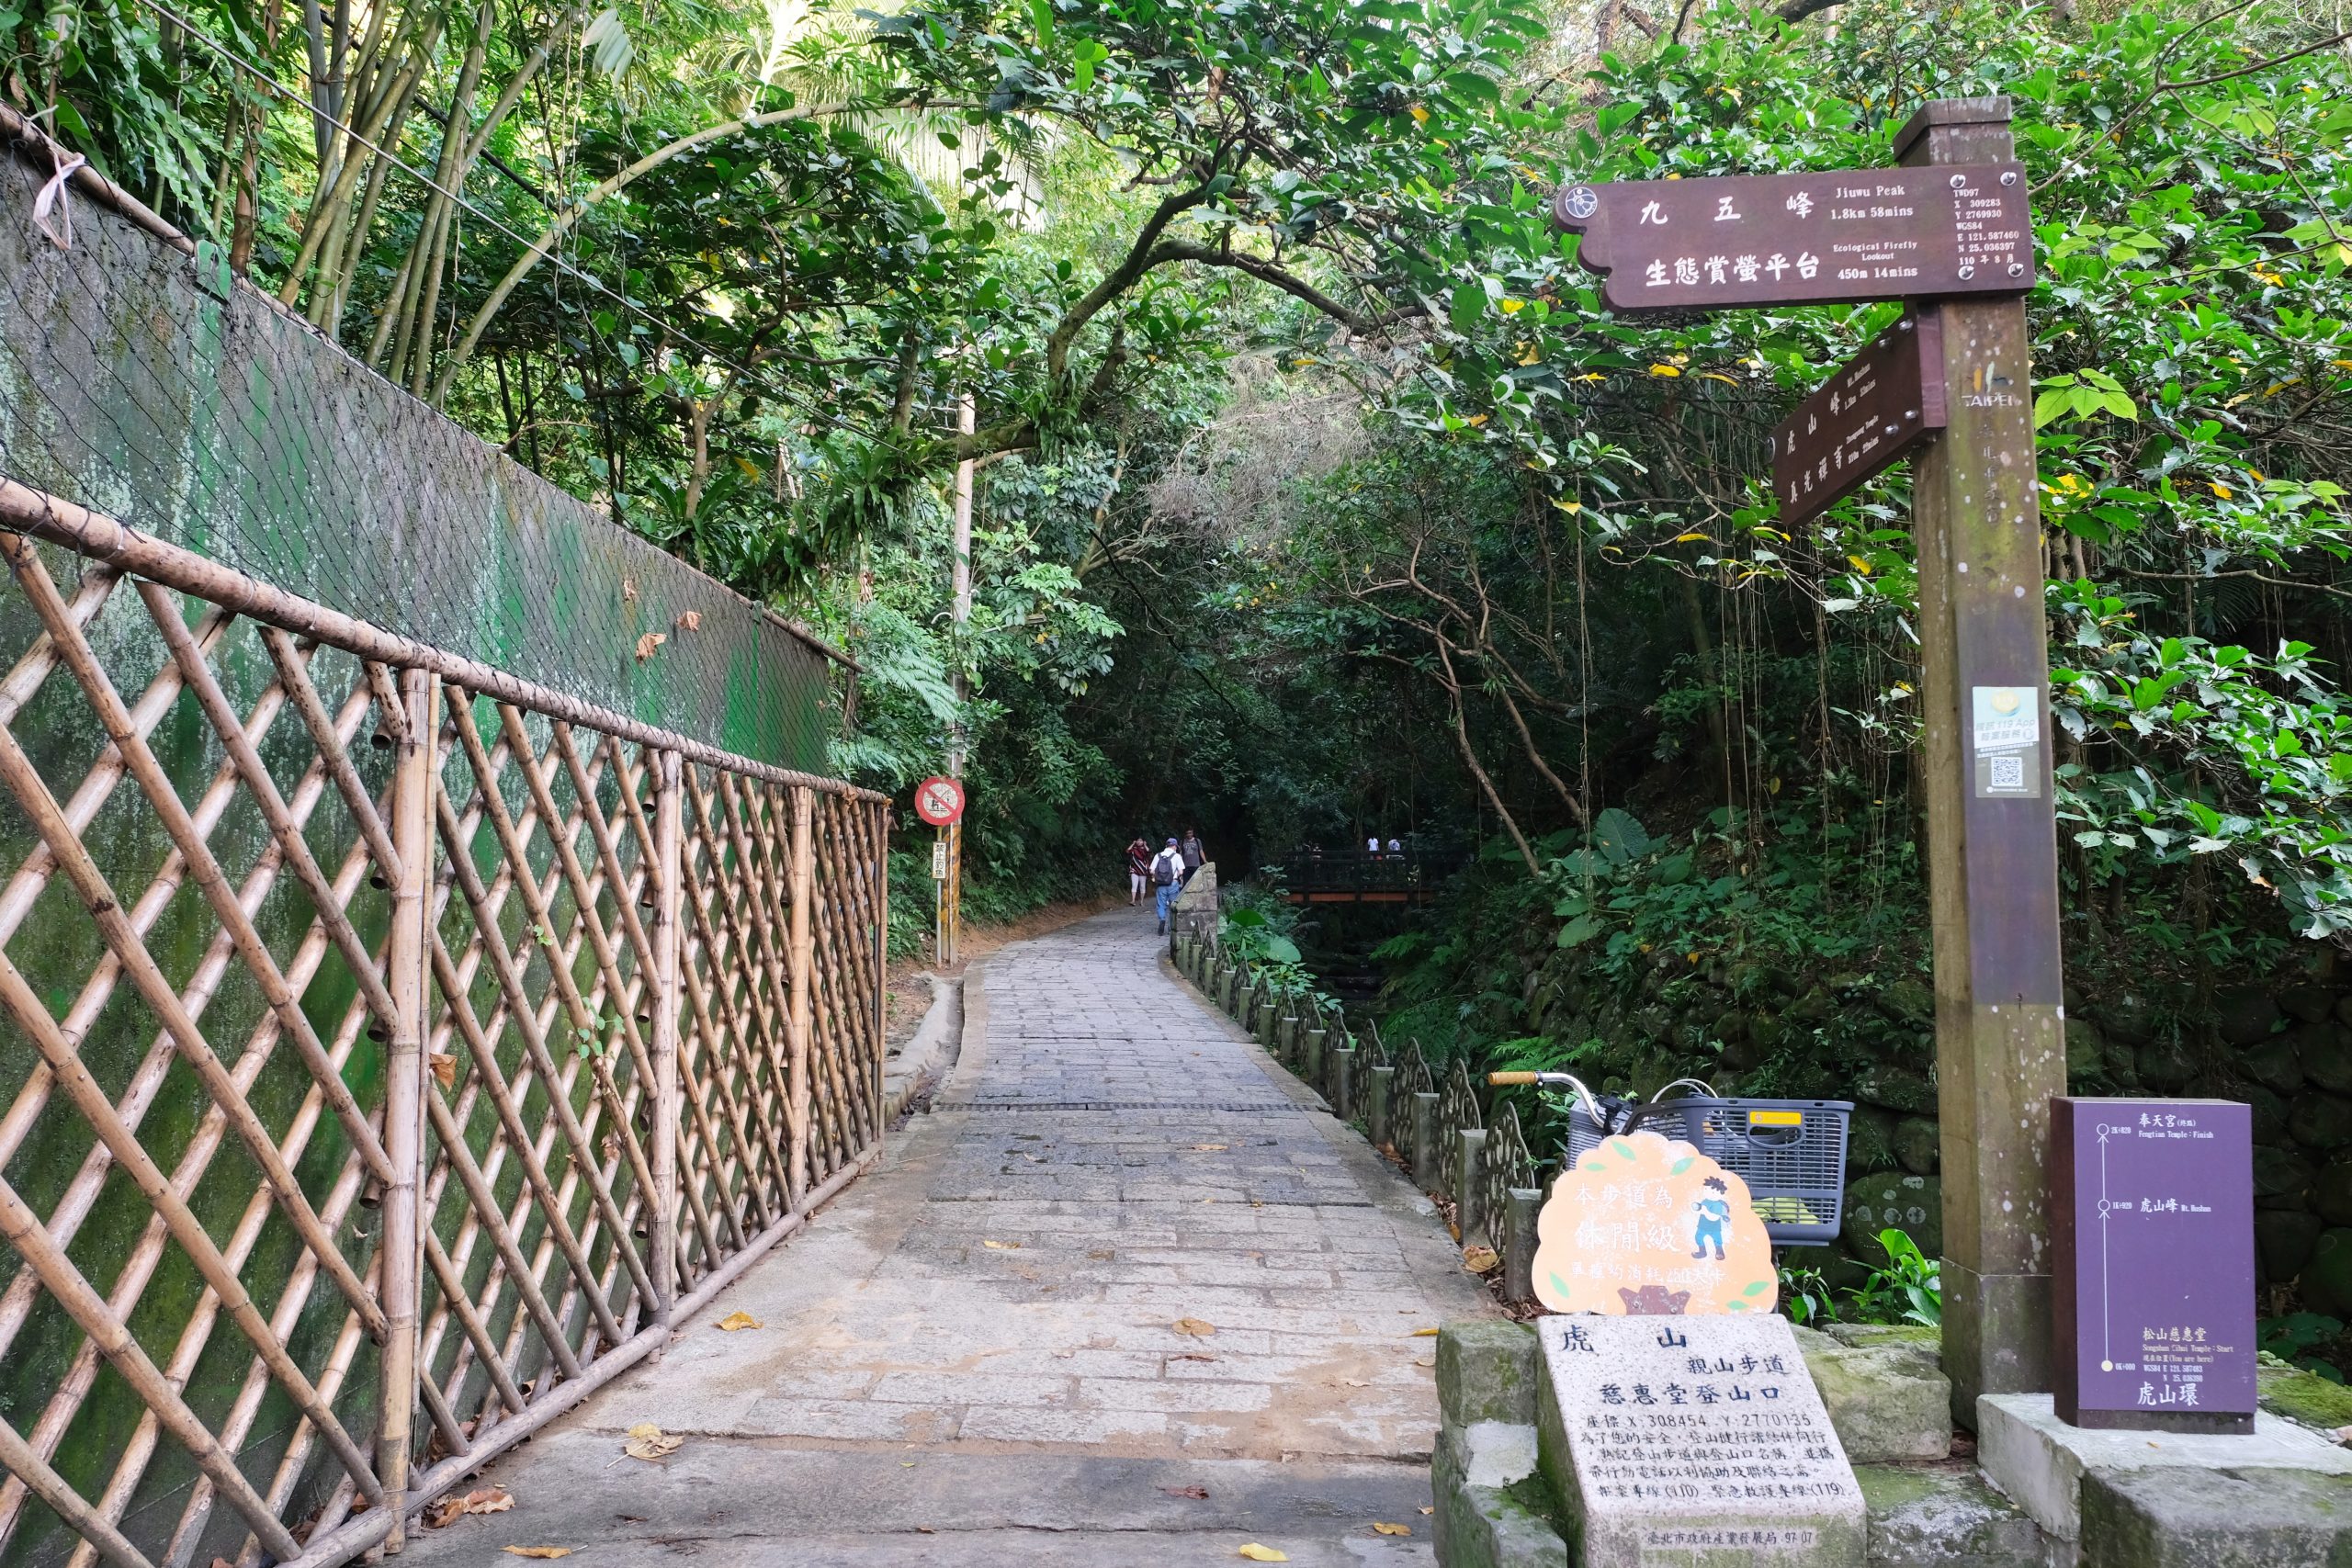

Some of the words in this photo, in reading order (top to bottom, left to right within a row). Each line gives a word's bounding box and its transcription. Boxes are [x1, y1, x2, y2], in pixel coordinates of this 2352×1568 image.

[1836, 186, 1871, 198] Jiuwu
[1876, 185, 1905, 197] Peak
[1953, 188, 1980, 197] TWD97
[1954, 200, 1961, 209] X
[1970, 198, 2001, 208] 309283
[1830, 208, 1866, 220] 1.8km
[1871, 206, 1914, 218] 58mins
[1955, 211, 1962, 220] Y
[1966, 209, 2002, 219] 2769930
[1956, 222, 1983, 231] WGS84
[1958, 233, 1963, 242] E
[1833, 243, 1880, 253] Ecological
[1884, 241, 1917, 252] Firefly
[1959, 244, 1964, 253] N
[1861, 253, 1894, 261] Lookout
[1645, 251, 1820, 287] 生態賞螢平台
[1837, 268, 1868, 279] 450m
[1874, 266, 1918, 277] 14mins
[1961, 395, 2013, 407] TAIPEI
[2140, 1197, 2178, 1213] 虎山峰
[1562, 1324, 1687, 1352] 虎山
[2143, 1326, 2207, 1342] 松山慈惠堂
[1688, 1355, 1791, 1376] 親山步道
[1600, 1382, 1779, 1405] 慈惠堂登山口
[2137, 1382, 2199, 1406] 虎山環
